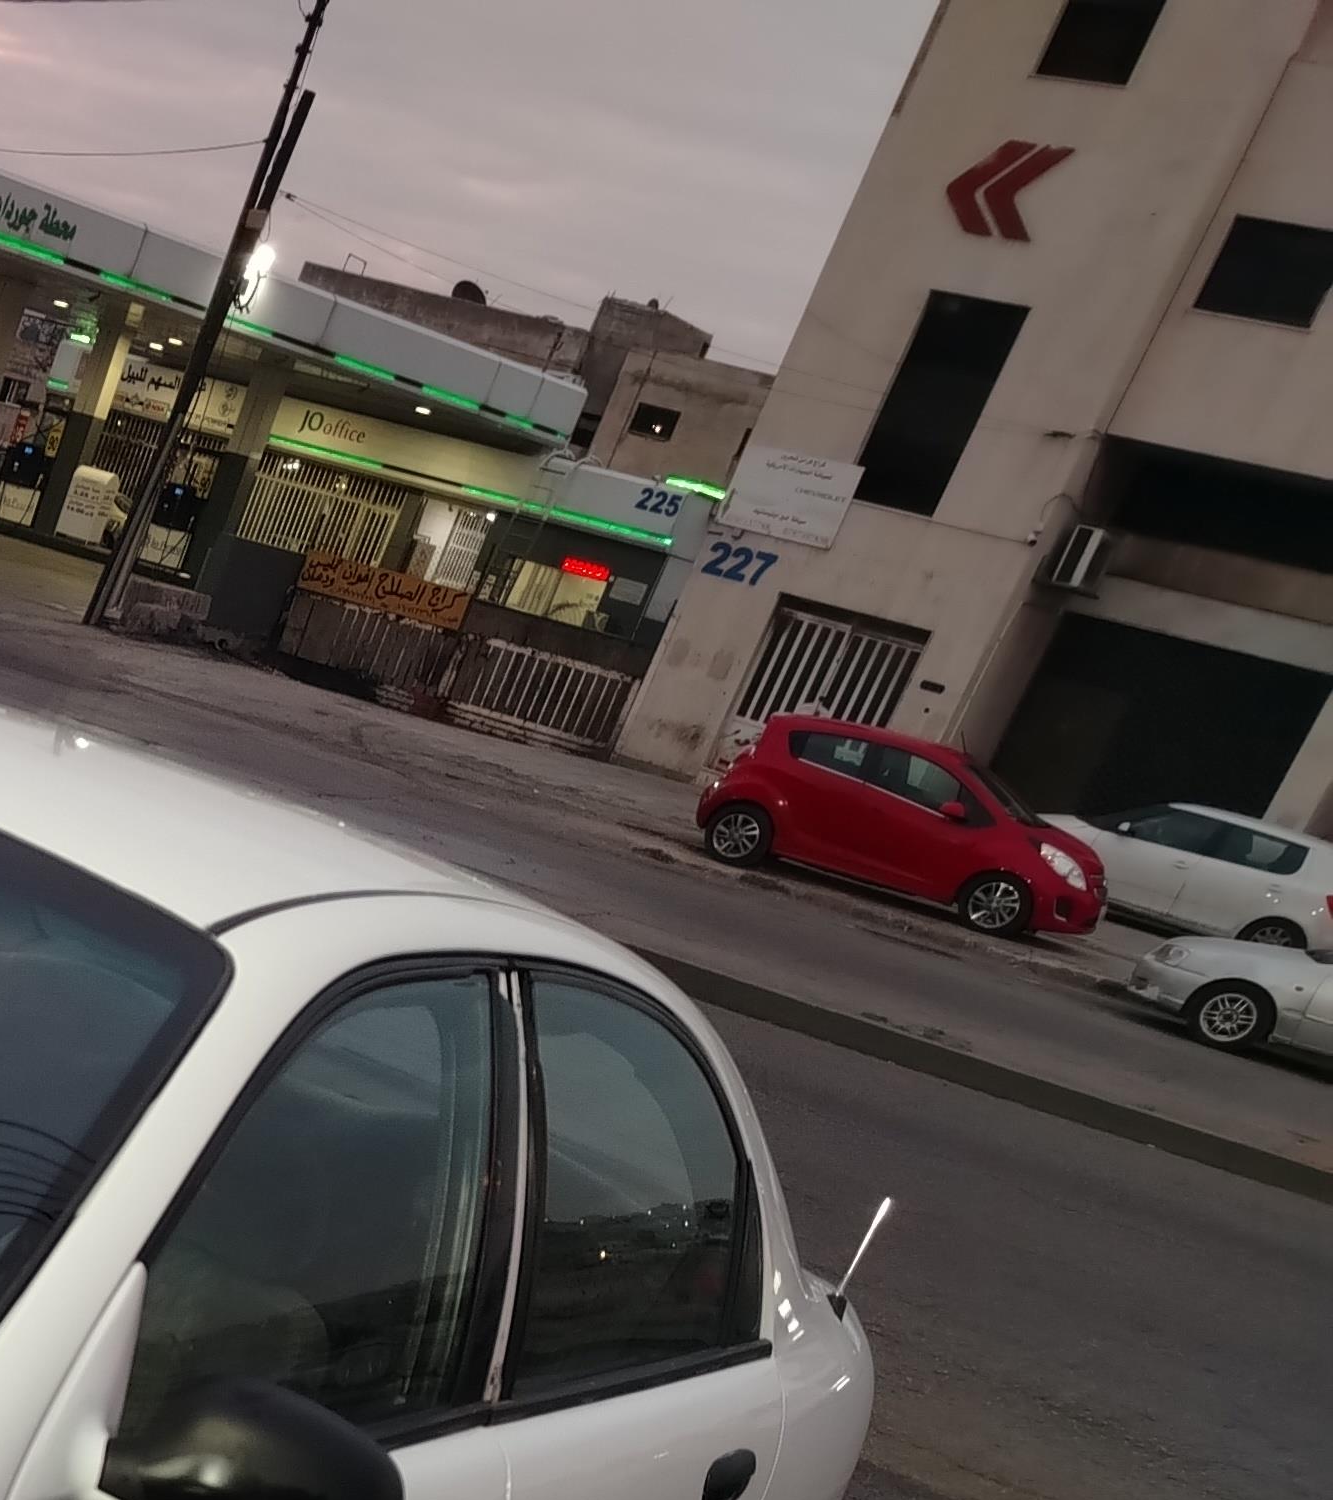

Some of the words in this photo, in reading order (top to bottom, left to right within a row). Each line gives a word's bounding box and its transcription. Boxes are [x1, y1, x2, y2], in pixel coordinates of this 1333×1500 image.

[38, 203, 77, 241] محطة
[298, 410, 324, 433] JO
[323, 418, 366, 443] office
[635, 487, 683, 517] 225
[701, 541, 779, 586] 227
